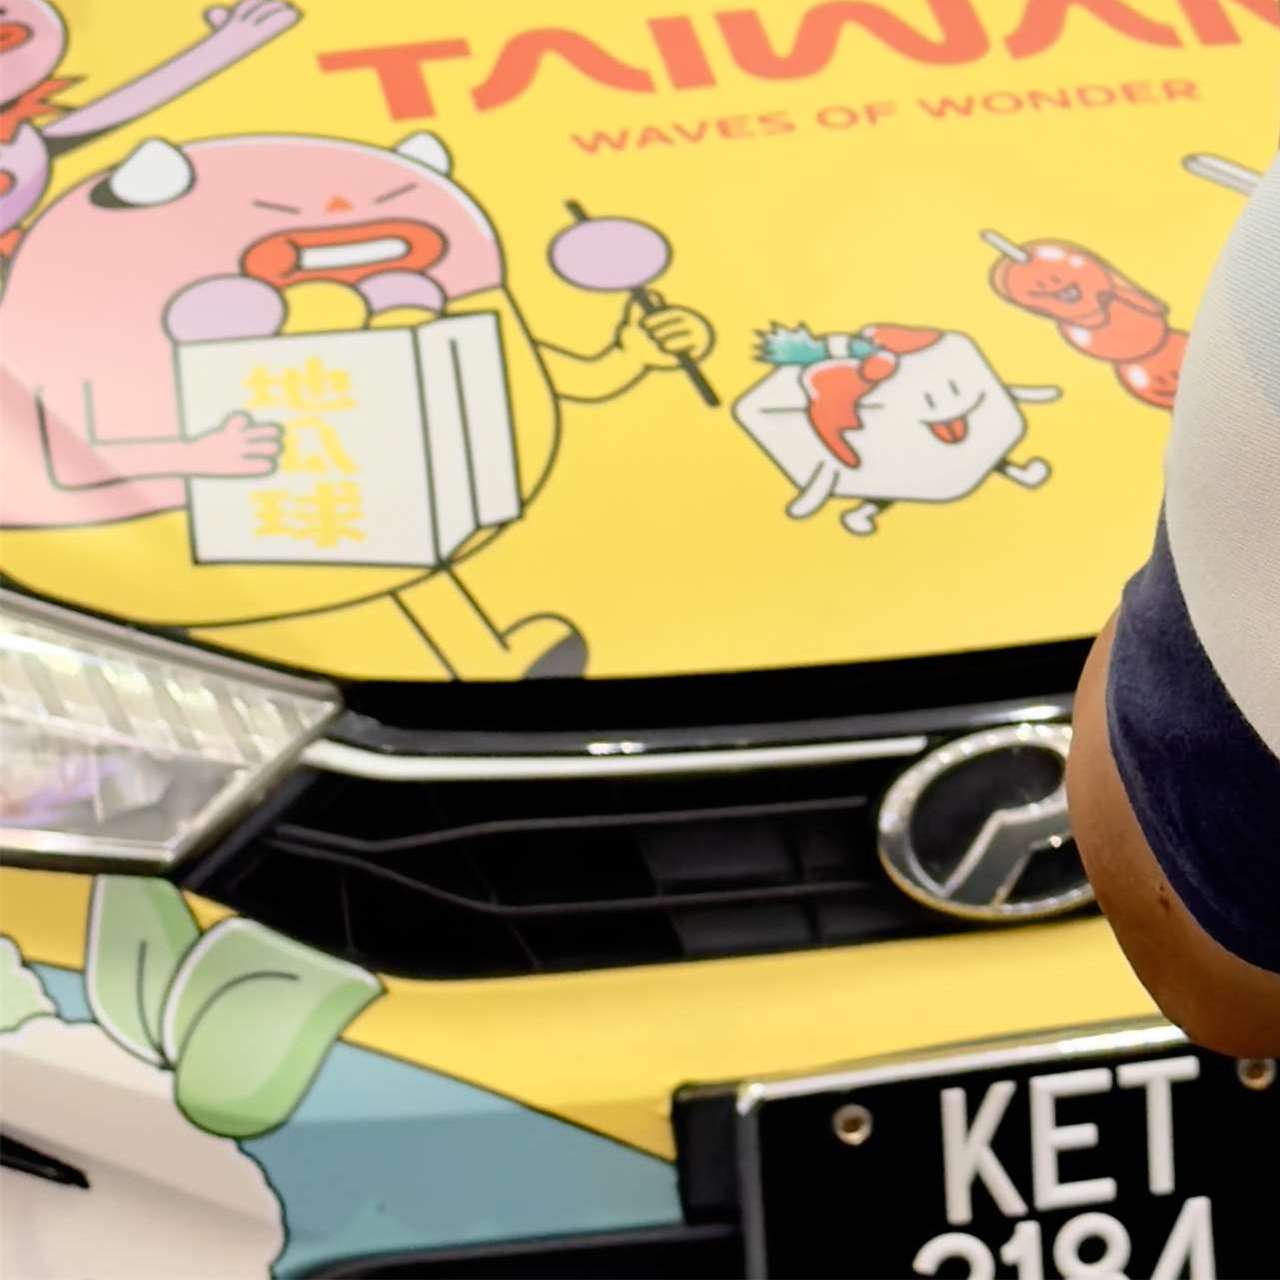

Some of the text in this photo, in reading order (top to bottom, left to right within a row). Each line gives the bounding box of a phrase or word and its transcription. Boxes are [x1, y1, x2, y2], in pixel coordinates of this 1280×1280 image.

[570, 78, 1204, 154] WAVES OF WONDER
[940, 1054, 1200, 1225] KET
